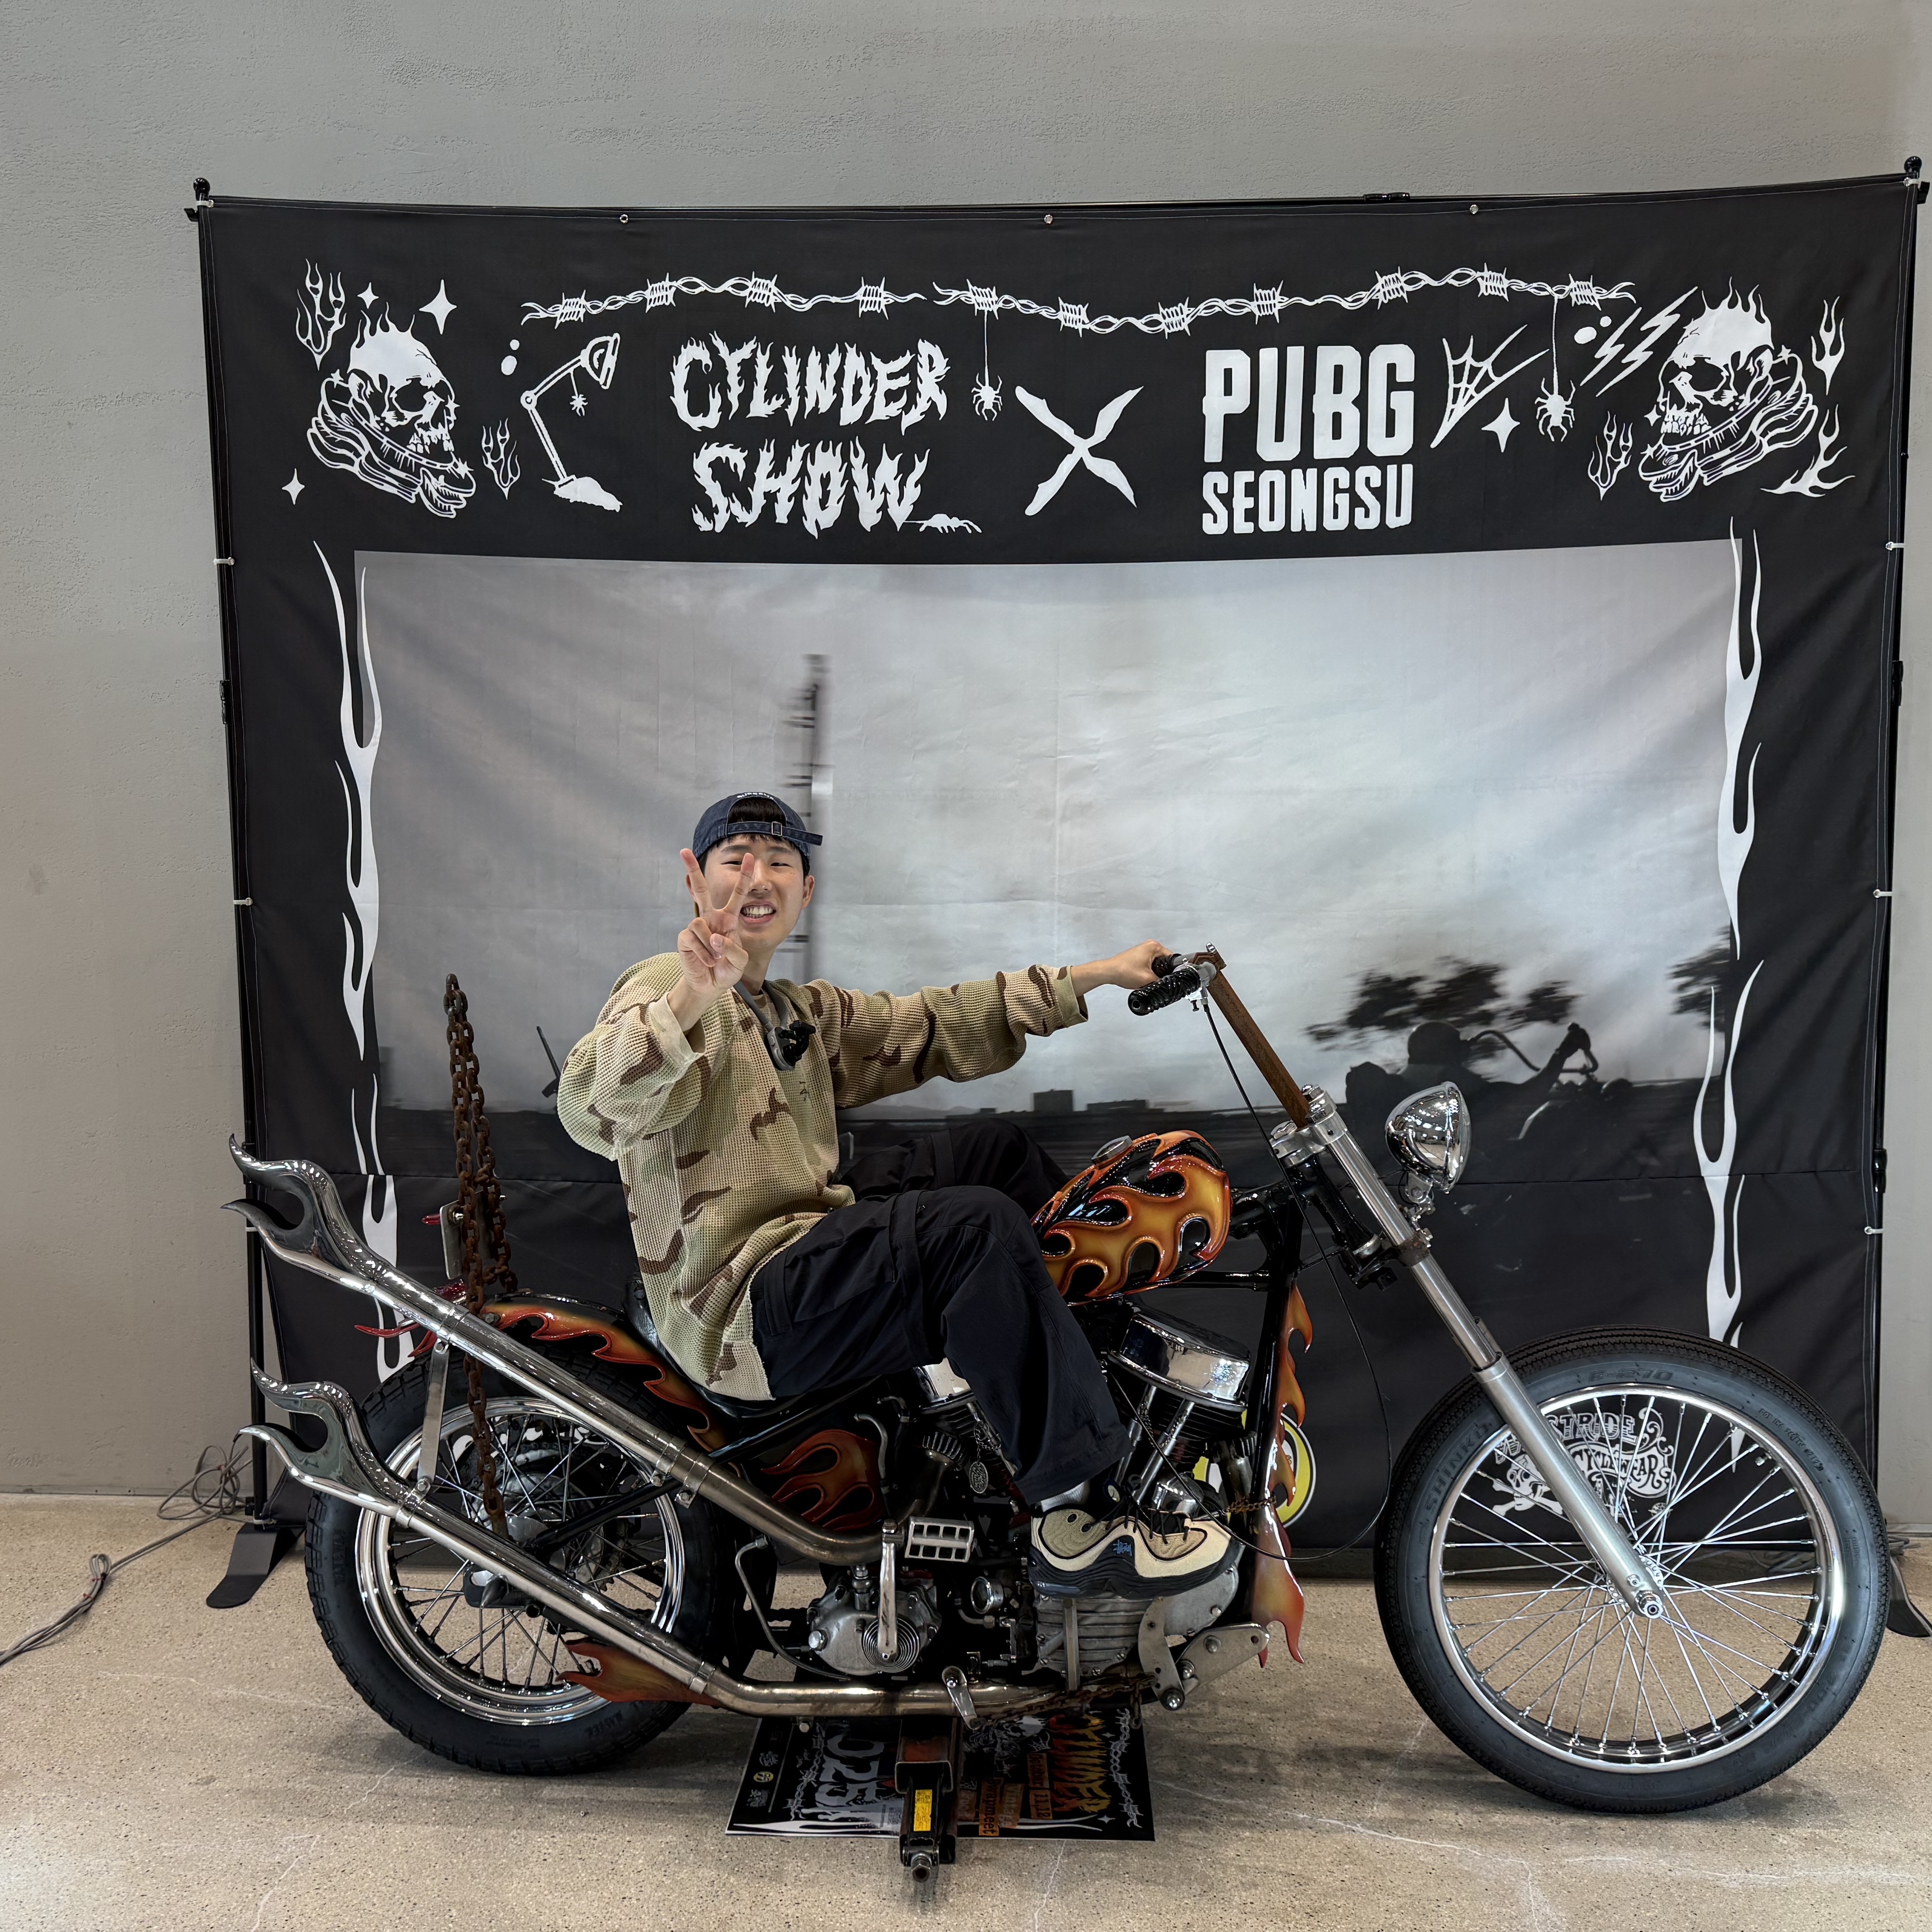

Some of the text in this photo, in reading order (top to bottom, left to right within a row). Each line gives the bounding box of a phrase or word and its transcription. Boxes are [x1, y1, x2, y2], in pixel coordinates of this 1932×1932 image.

[670, 337, 951, 436] CYLINDER
[1202, 344, 1415, 463] PUBG
[691, 436, 930, 539] SHOW
[1202, 464, 1413, 535] SEONGSU
[1425, 1422, 1489, 1511] SHINKO
